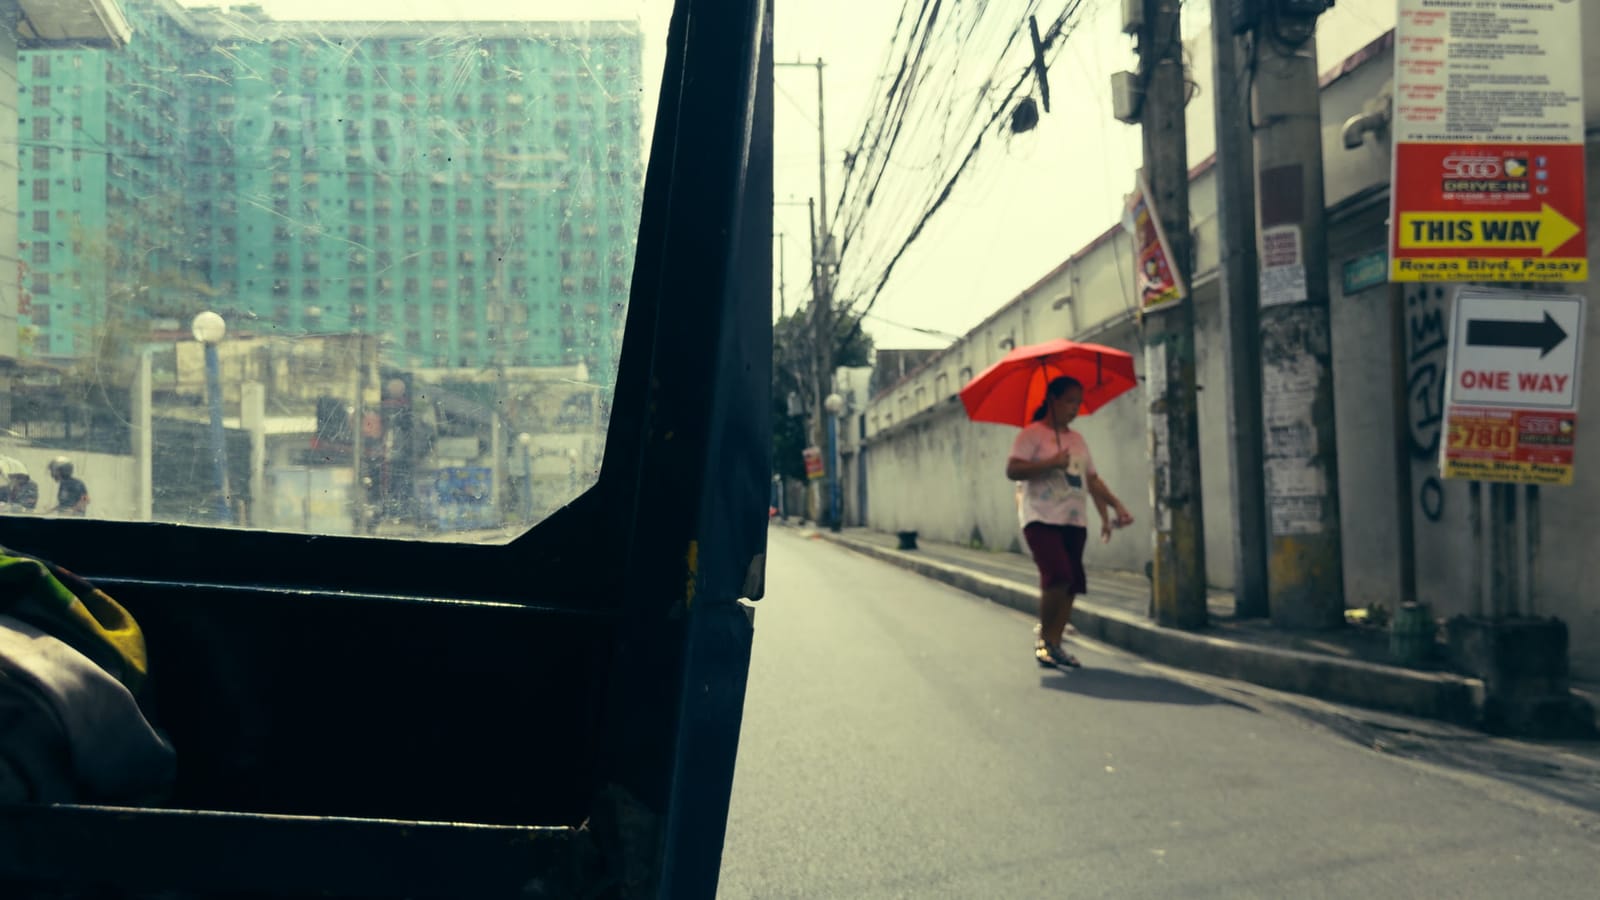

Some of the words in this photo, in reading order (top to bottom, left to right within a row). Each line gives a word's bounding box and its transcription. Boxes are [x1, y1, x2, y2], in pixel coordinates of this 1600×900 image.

[1442, 156, 1500, 178] SOGO
[1444, 181, 1528, 192] DRIVE-IN
[1410, 220, 1474, 241] THIS
[1480, 220, 1541, 241] WAY
[1399, 259, 1459, 271] Roxas
[1522, 259, 1582, 273] Pasay
[1460, 370, 1511, 390] ONE
[1517, 372, 1569, 394] WAY
